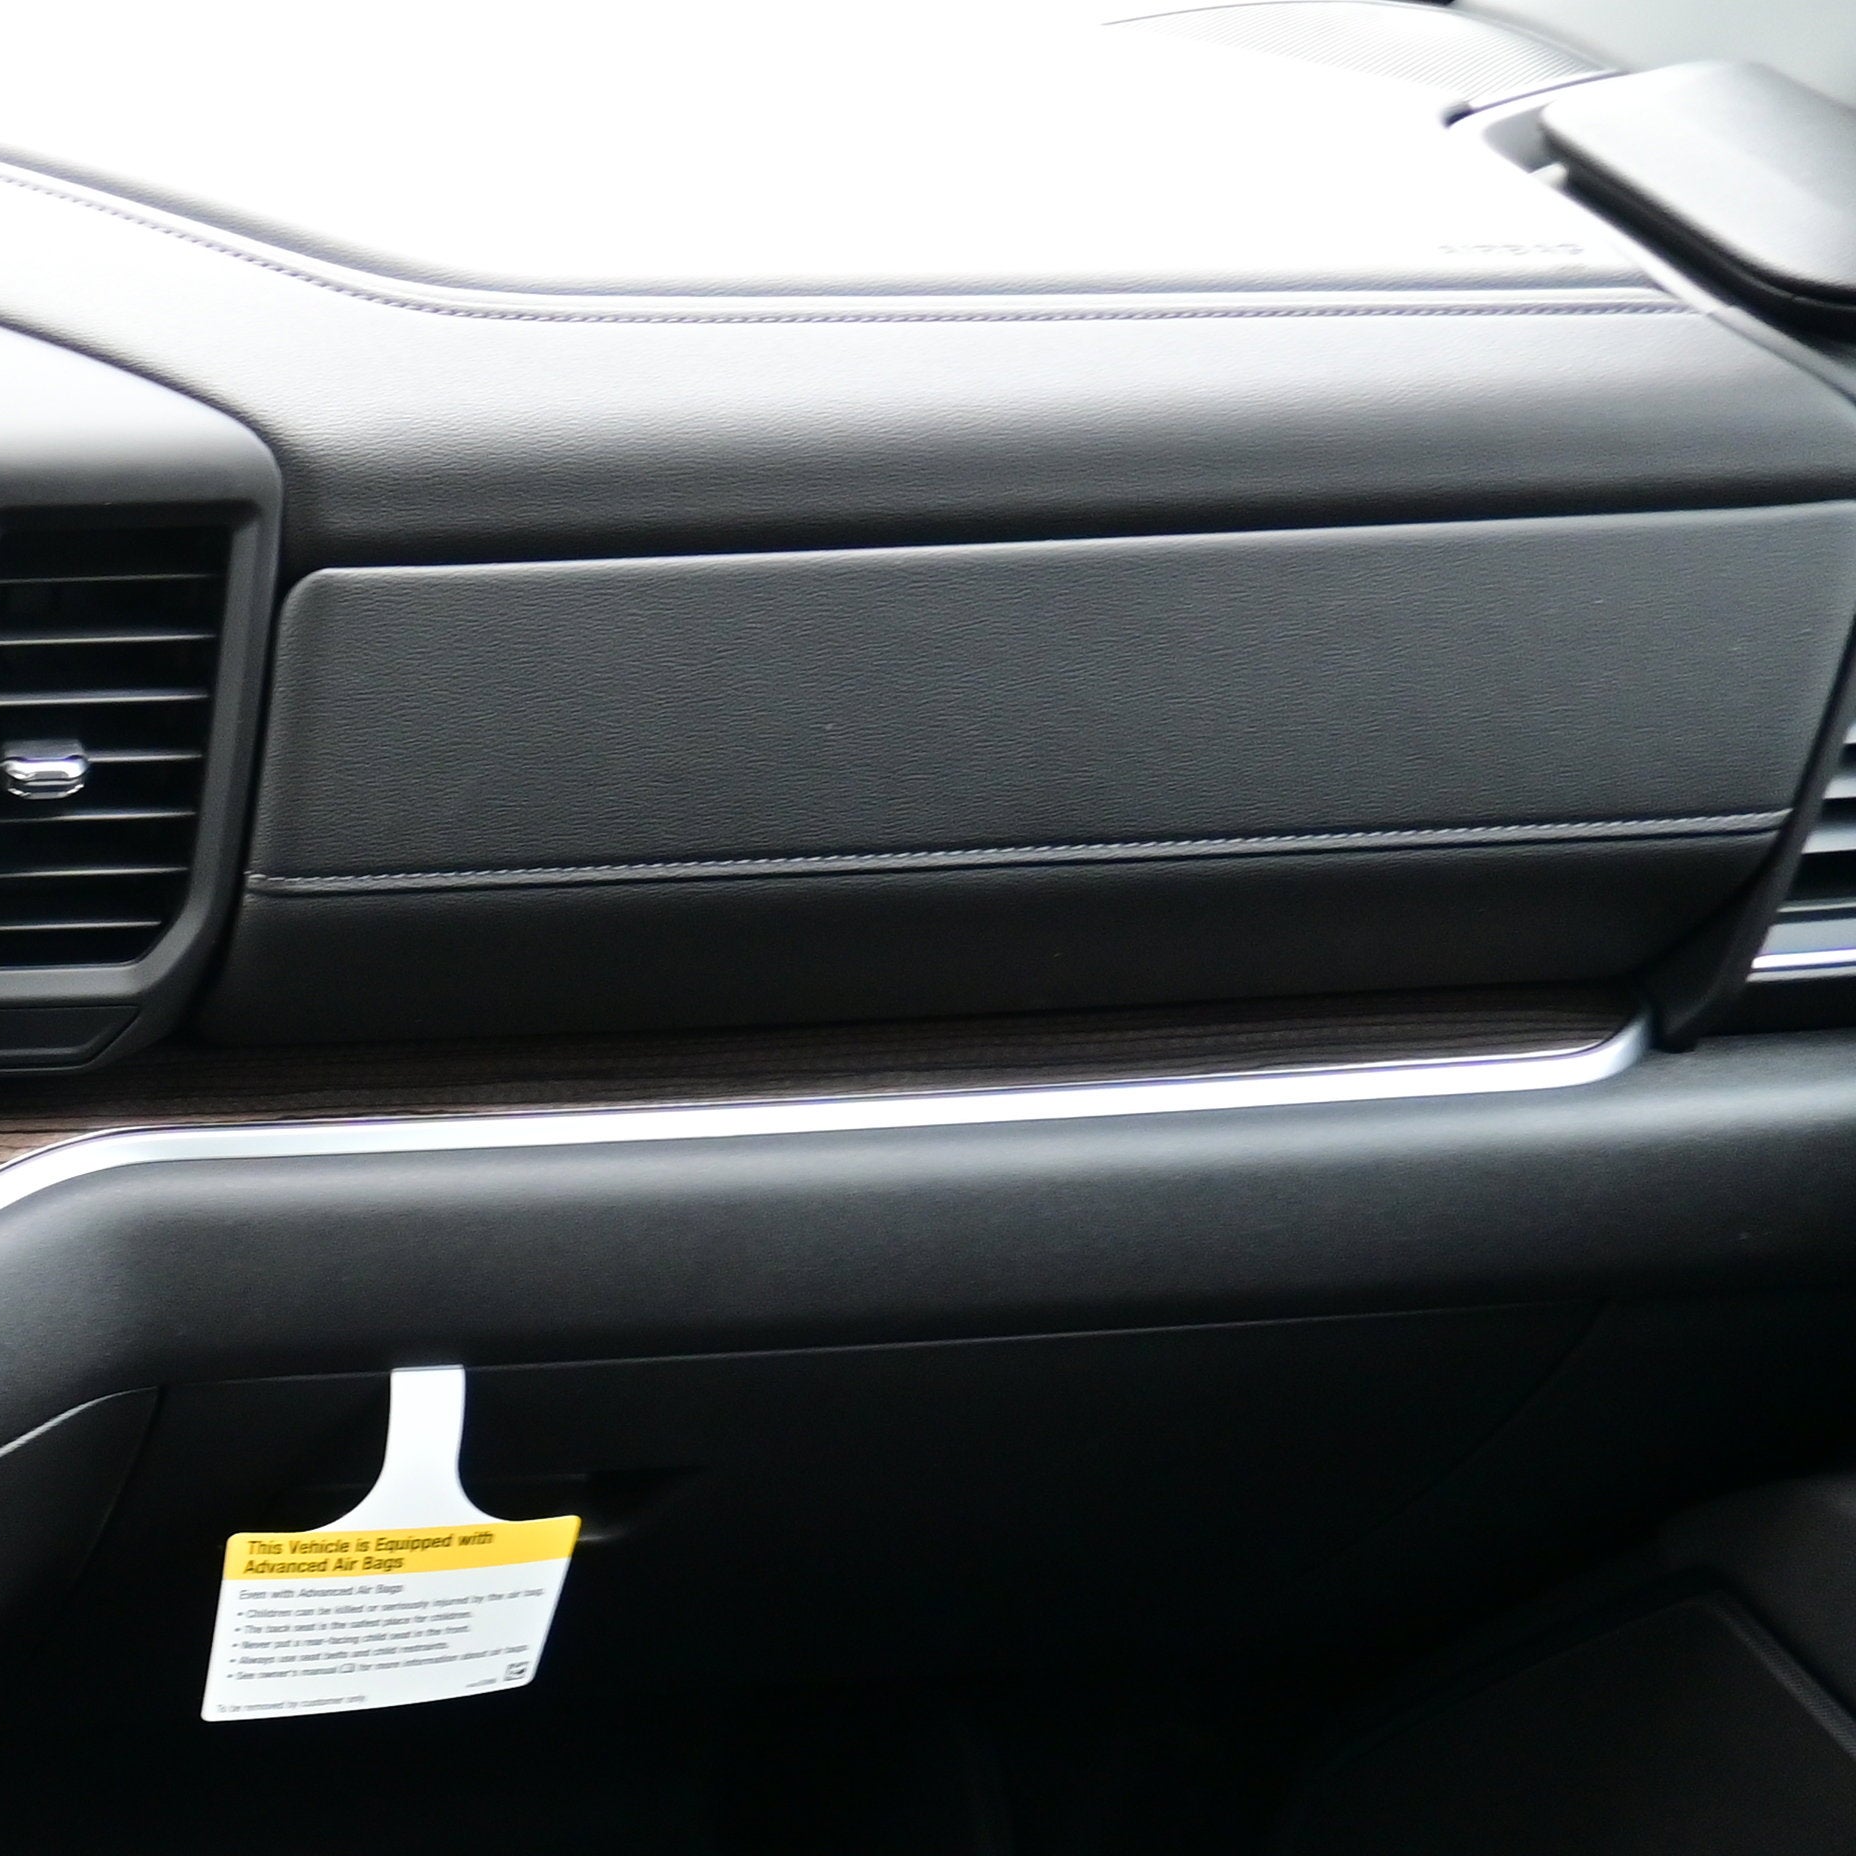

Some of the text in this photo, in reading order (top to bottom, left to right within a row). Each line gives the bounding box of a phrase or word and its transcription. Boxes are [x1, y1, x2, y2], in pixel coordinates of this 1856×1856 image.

[248, 1531, 494, 1556] This Vehicle is Equipped with
[243, 1555, 405, 1575] Advanced Air Bags
